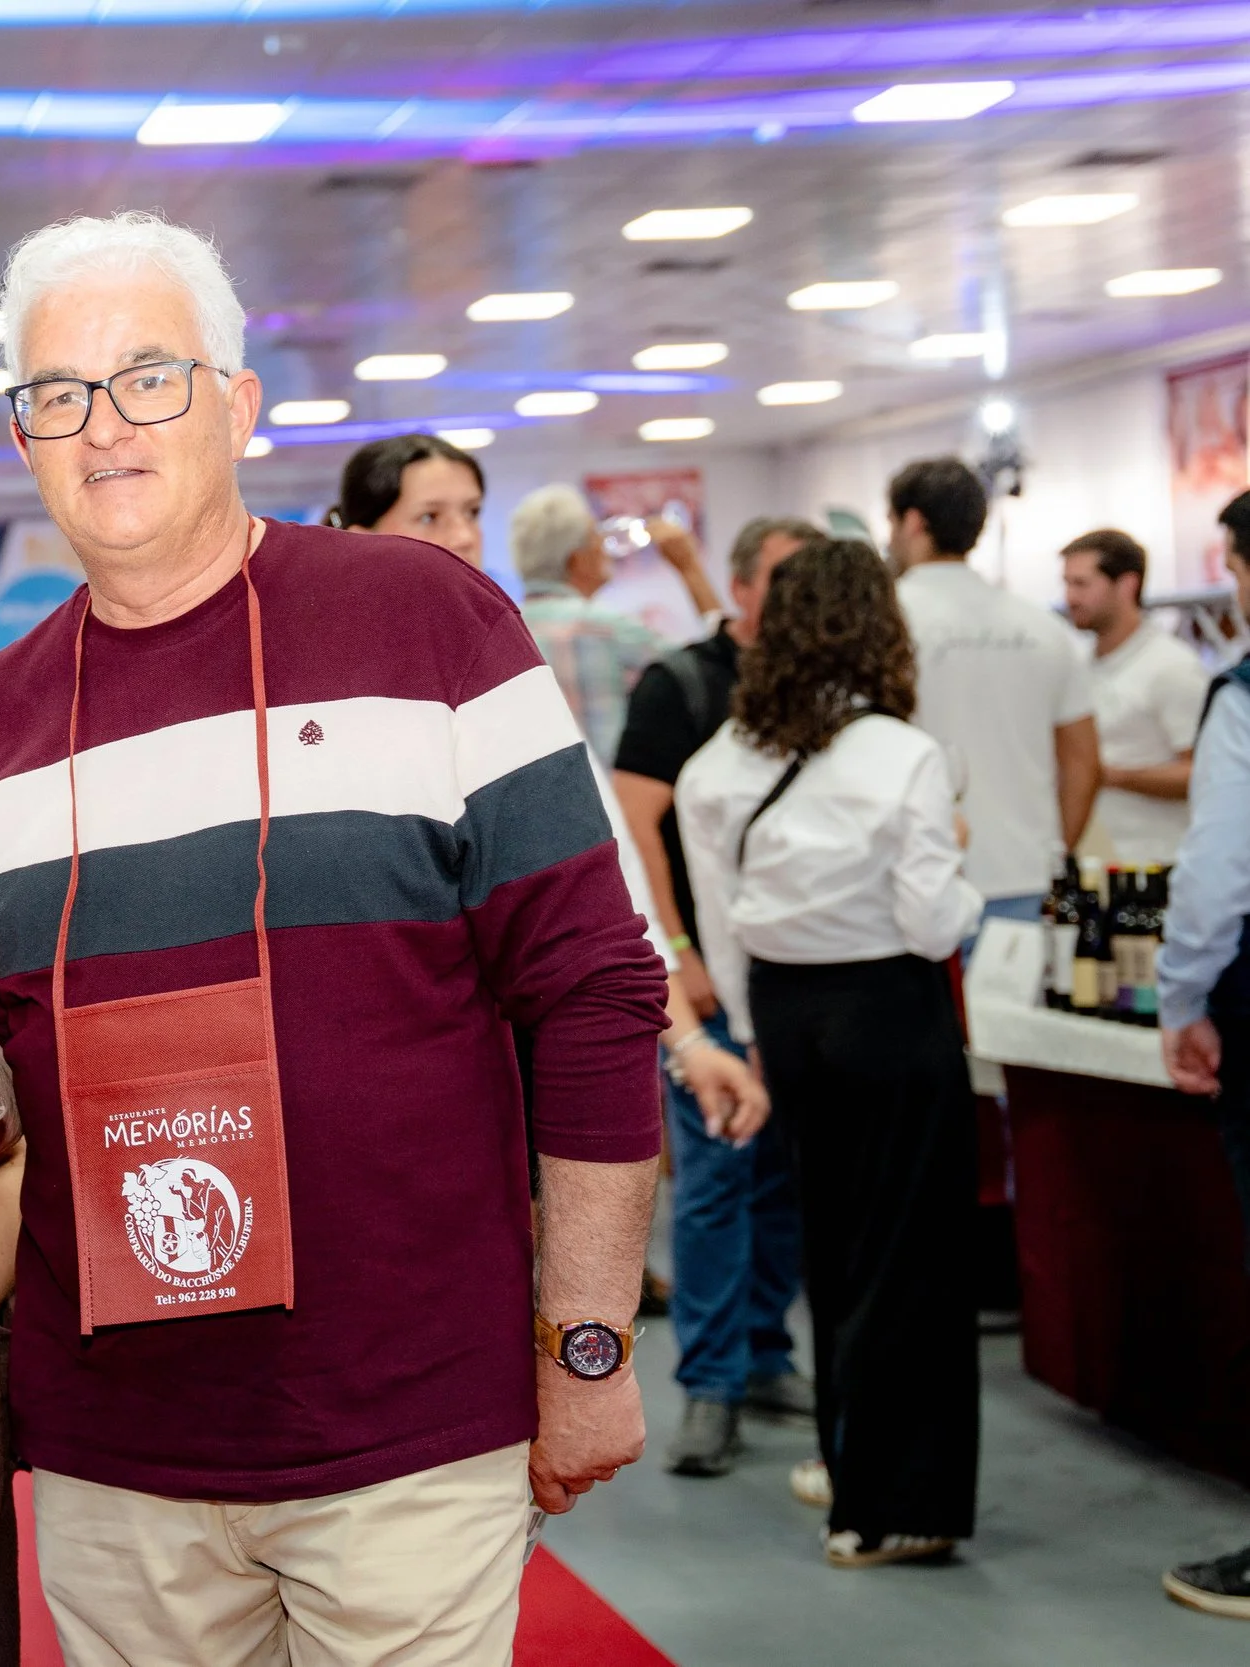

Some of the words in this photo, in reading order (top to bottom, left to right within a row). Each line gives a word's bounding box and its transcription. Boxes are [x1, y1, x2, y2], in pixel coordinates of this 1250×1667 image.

[176, 1131, 254, 1149] MEMORIES
[124, 1213, 157, 1275] CONFRARIA
[156, 1269, 172, 1284] DO
[172, 1270, 223, 1289] BACCHUS
[220, 1259, 236, 1276] DE
[232, 1196, 254, 1263] ALBUFEIRA
[154, 1294, 177, 1306] Tel:
[178, 1291, 197, 1304] 962
[198, 1289, 217, 1301] 228
[218, 1286, 237, 1299] 930
